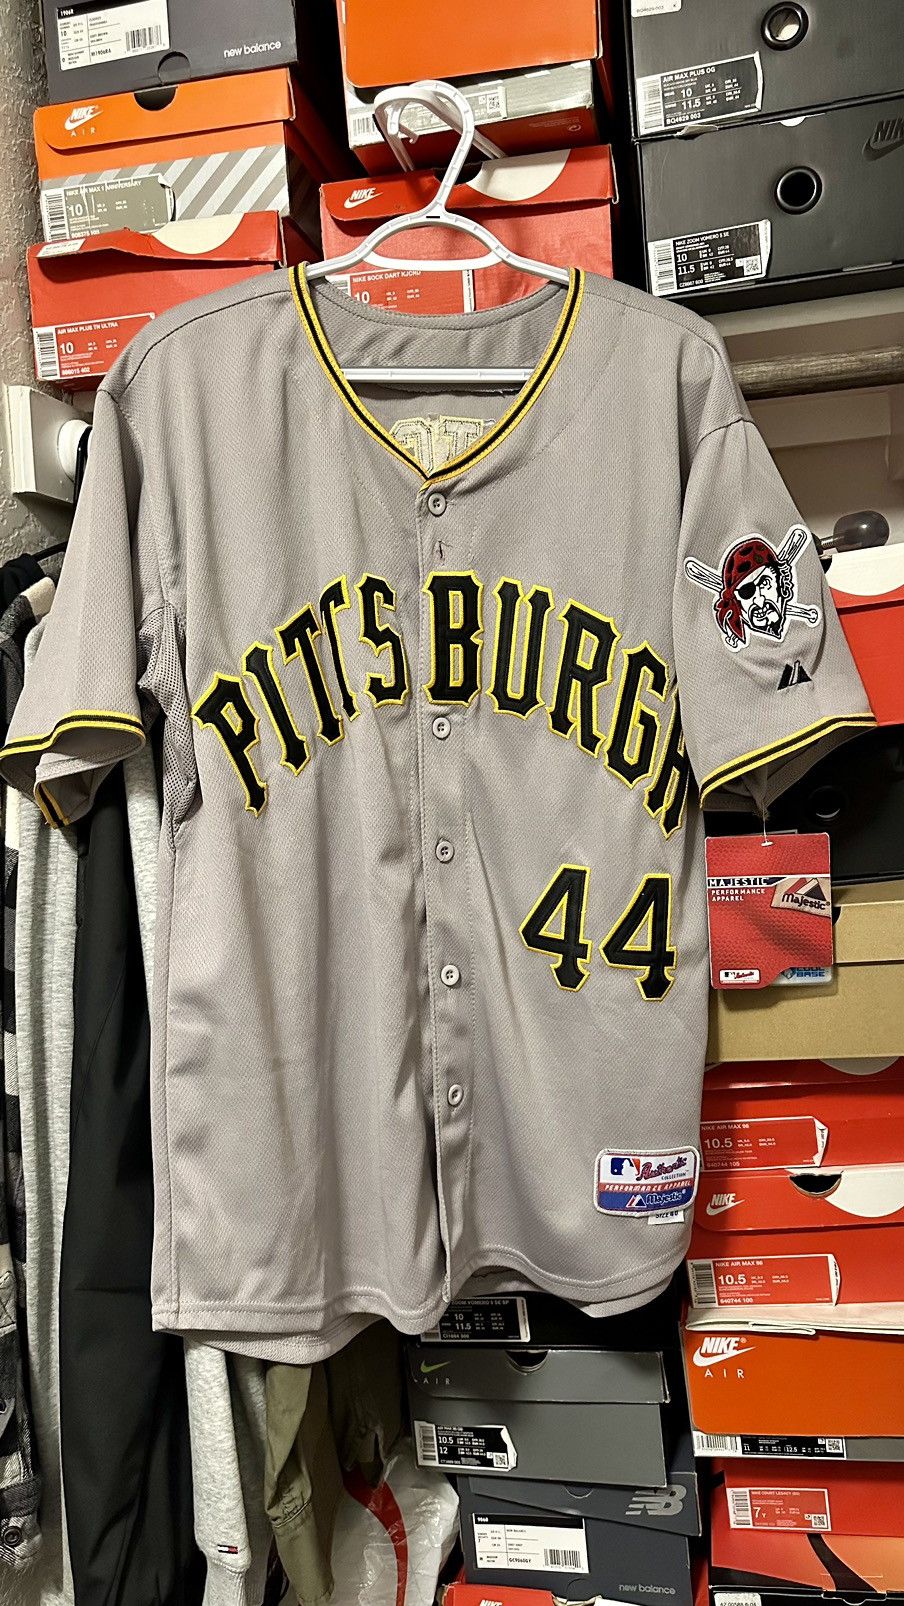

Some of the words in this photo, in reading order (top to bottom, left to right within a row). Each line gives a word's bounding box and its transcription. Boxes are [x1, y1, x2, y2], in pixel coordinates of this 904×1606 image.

[224, 48, 242, 58] new
[244, 41, 282, 54] balance
[674, 72, 688, 81] MAX
[690, 69, 705, 78] PLUS
[681, 88, 692, 98] 10
[682, 99, 701, 110] 11.5
[70, 105, 96, 120] NIKE
[71, 127, 95, 137] AIR
[351, 188, 376, 200] NIKE
[69, 204, 83, 216] 10
[677, 253, 687, 262] 10
[678, 265, 695, 275] 11.5
[354, 291, 370, 303] 10
[60, 342, 74, 354] 10
[709, 878, 768, 887] MAJESTIC
[518, 863, 678, 1002] 44
[704, 1138, 733, 1148] 10.5
[664, 1180, 691, 1190] APPAREL
[646, 1191, 682, 1205] Majestic
[711, 1193, 736, 1206] NIKE
[718, 1274, 746, 1284] 10.5
[701, 1337, 740, 1354] NIKE
[704, 1368, 744, 1379] AIR
[753, 1507, 761, 1518] 7
[638, 1584, 676, 1595] balance
